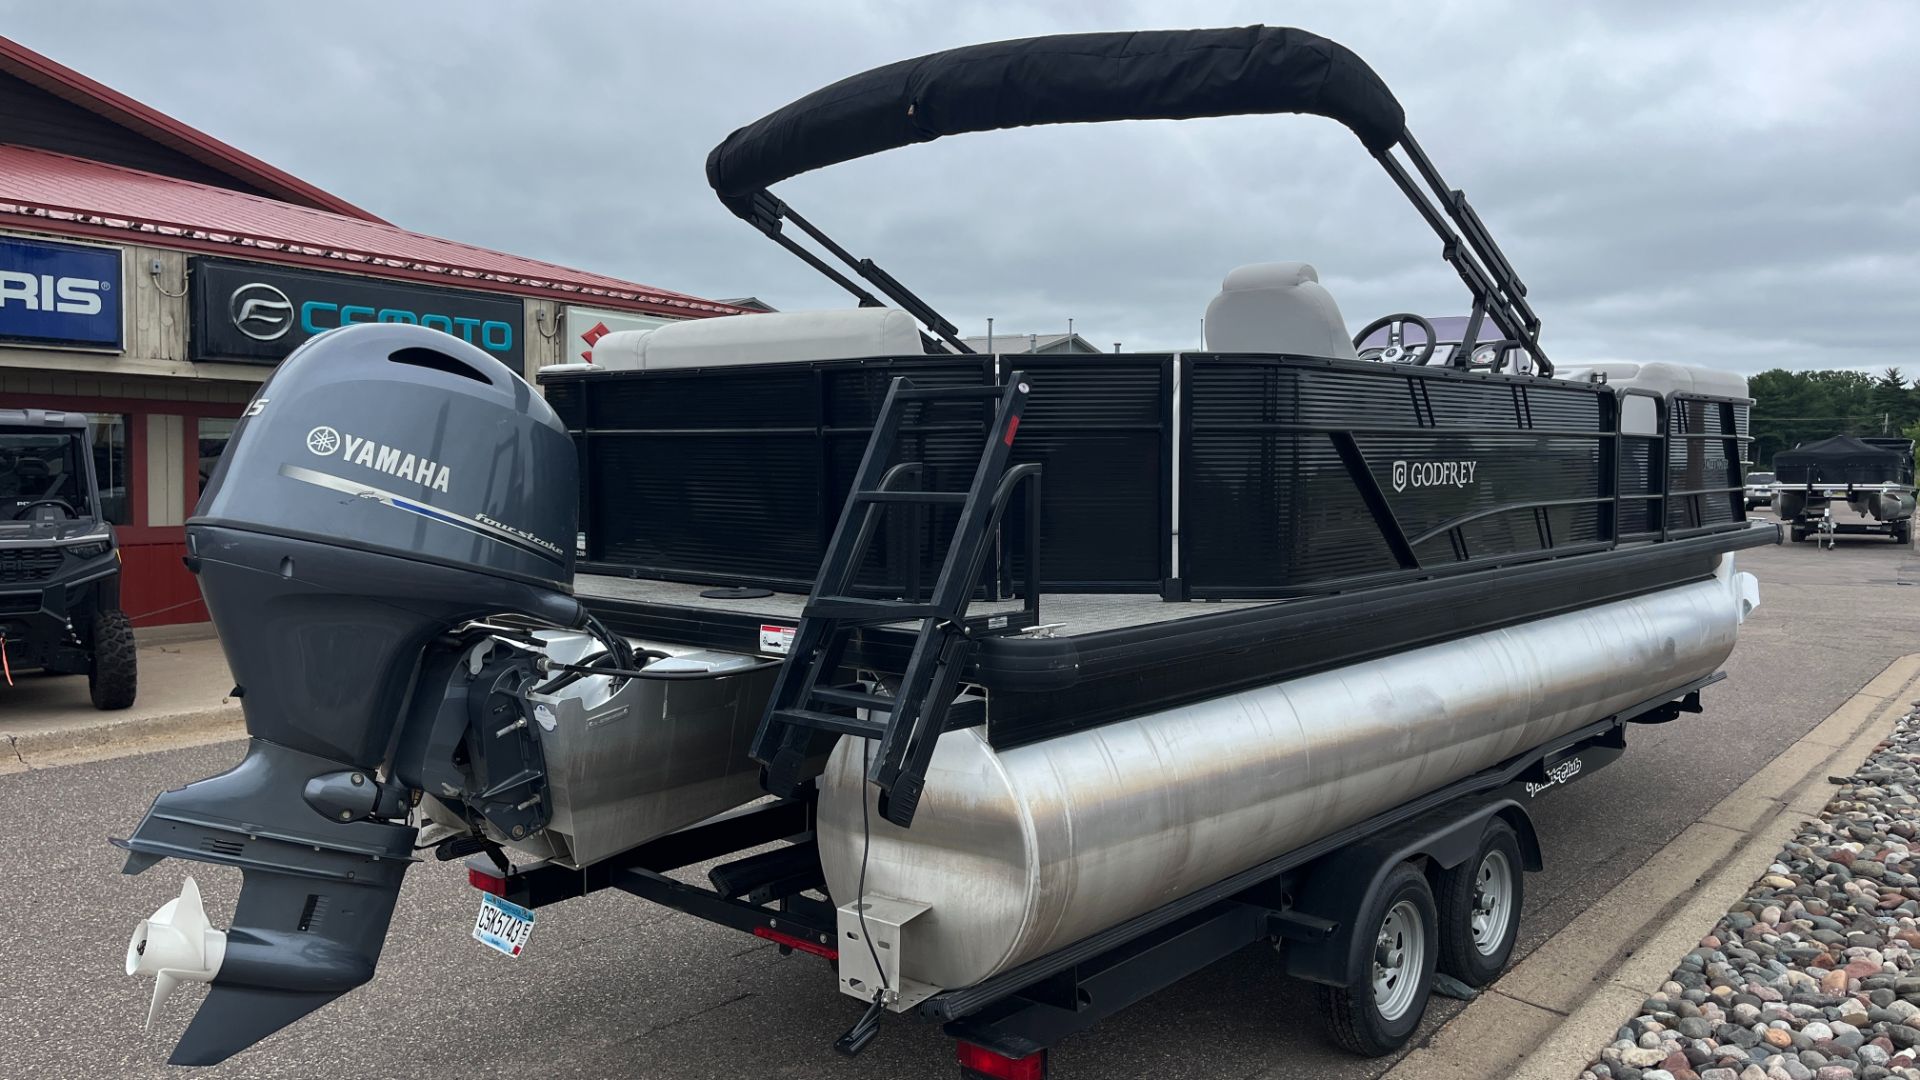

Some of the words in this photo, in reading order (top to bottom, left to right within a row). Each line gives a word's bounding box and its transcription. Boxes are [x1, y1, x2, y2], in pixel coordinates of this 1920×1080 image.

[343, 433, 451, 493] YAMAHA
[1411, 461, 1477, 488] GODFREY
[478, 905, 523, 943] CSK5743
